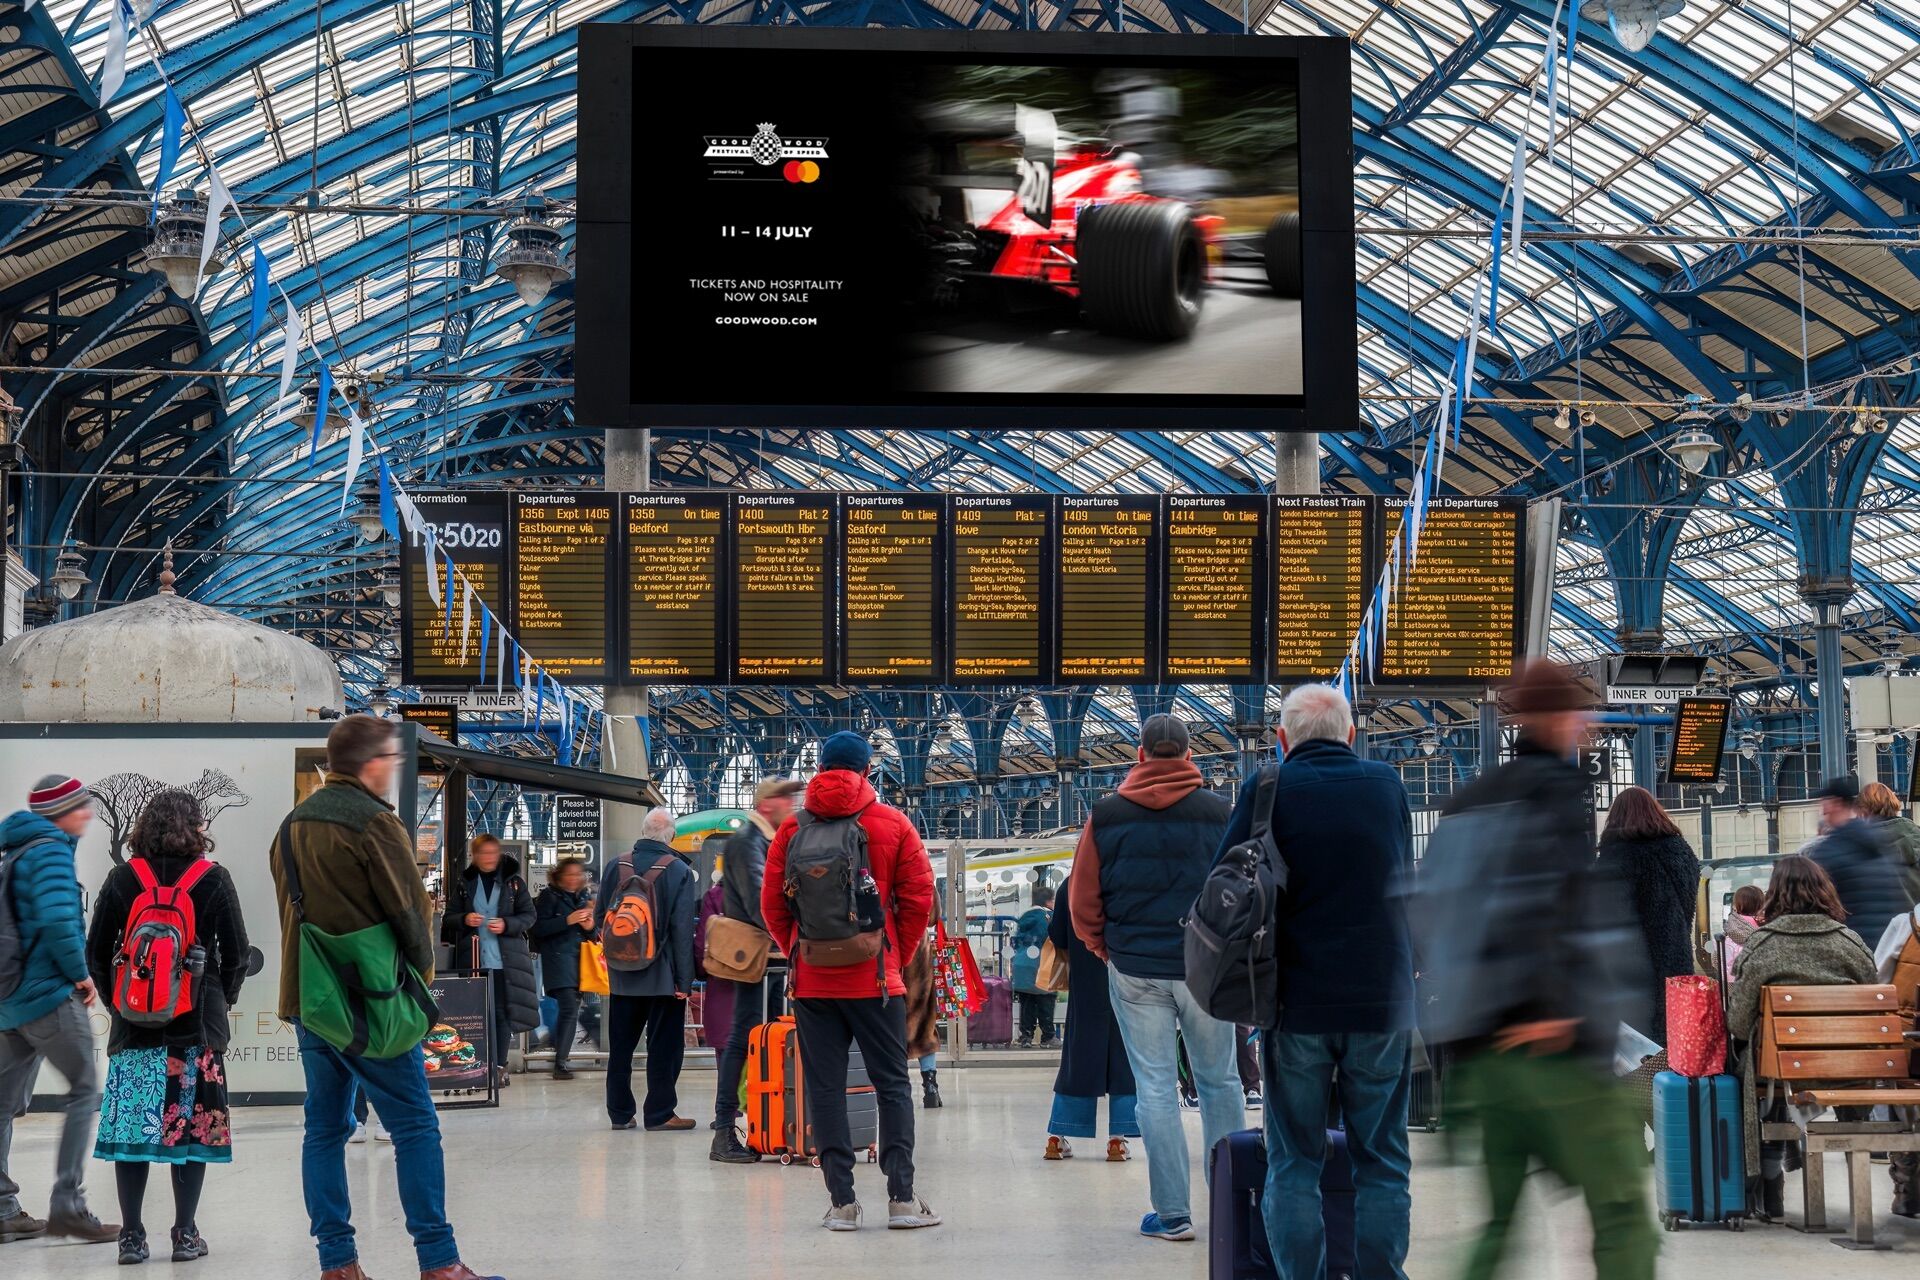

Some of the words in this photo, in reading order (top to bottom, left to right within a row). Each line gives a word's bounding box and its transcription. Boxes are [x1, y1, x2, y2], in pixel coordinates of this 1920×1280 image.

[722, 226, 735, 237] 11
[756, 226, 772, 237] 14
[774, 226, 813, 241] JULY
[689, 279, 737, 289] TICKETS
[739, 279, 766, 289] AND
[770, 280, 843, 290] HOSPITALITY
[724, 292, 755, 302] NOW
[759, 292, 778, 302] ON
[782, 293, 809, 303] SALE
[715, 316, 817, 326] GOODWOOD.COM
[519, 494, 576, 505] Departures
[629, 495, 686, 506] Departures
[738, 495, 795, 506] Departures
[847, 496, 904, 507] Departures
[955, 497, 1012, 508] Departures
[1063, 497, 1119, 508] Departures
[1170, 497, 1226, 507] Departures
[1277, 497, 1300, 507] Next
[1303, 497, 1339, 507] Fastest
[1341, 497, 1366, 507] Train
[1384, 498, 1442, 507] Subseent
[1445, 498, 1499, 509] Departures
[520, 508, 545, 519] 1356
[557, 508, 580, 520] Expt
[586, 508, 610, 519] 1405
[630, 509, 655, 519] 1358
[684, 509, 696, 519] On
[701, 509, 720, 519] time
[740, 509, 764, 520] 1400
[799, 509, 818, 520] Plat
[822, 509, 829, 520] 2
[849, 510, 873, 520] 1406
[901, 510, 913, 520] On
[918, 510, 937, 520] time
[957, 511, 981, 521] 1409
[1015, 511, 1034, 521] Plat
[1064, 511, 1088, 521] 1409
[1116, 511, 1128, 521] On
[1132, 511, 1152, 521] time
[1171, 511, 1195, 521] 1414
[1223, 511, 1235, 521] On
[1239, 511, 1258, 521] time
[519, 522, 575, 533] Eastbourne
[580, 523, 594, 533] via
[629, 523, 668, 533] Bedford
[738, 523, 794, 534] Portsmouth
[798, 523, 816, 534] Hbr
[847, 524, 886, 534] Seaford
[955, 525, 979, 535] Hove
[1063, 525, 1097, 535] London
[1100, 525, 1137, 535] Victoria
[1170, 525, 1217, 536] Cambridge
[519, 536, 541, 544] Calling
[658, 546, 676, 554] note,
[967, 547, 989, 555] Change
[1063, 547, 1091, 555] Haywards
[669, 555, 693, 563] Bridges
[756, 555, 786, 563] disrupted
[468, 563, 484, 571] YOUR
[645, 565, 677, 573] currently
[1183, 566, 1210, 574] Finsbury
[992, 585, 1021, 593] Worthing,
[519, 602, 548, 610] Polegate
[847, 602, 885, 610] Bishopstone
[1006, 603, 1037, 611] Angmering
[1405, 603, 1435, 611] Cambridge
[519, 611, 546, 619] Hampden
[1405, 612, 1447, 620] Littlehampton
[847, 667, 898, 675] Southern
[955, 667, 1005, 675] Southern
[1062, 667, 1097, 675] Gatwick
[1101, 667, 1140, 676] Express
[1382, 668, 1402, 676] Page
[1468, 667, 1511, 676] 13:50:20
[1612, 689, 1647, 700] INNER
[1655, 689, 1693, 700] OUTER
[423, 696, 468, 706] OUTER
[477, 695, 516, 706] INNER
[1588, 752, 1602, 776] 3
[562, 800, 585, 808] Please
[585, 800, 595, 808] be
[558, 810, 584, 818] advised
[585, 810, 600, 818] that
[561, 820, 577, 828] train
[577, 820, 597, 828] doors
[563, 830, 575, 838] will
[576, 830, 594, 838] close
[222, 1047, 263, 1062] RAFT
